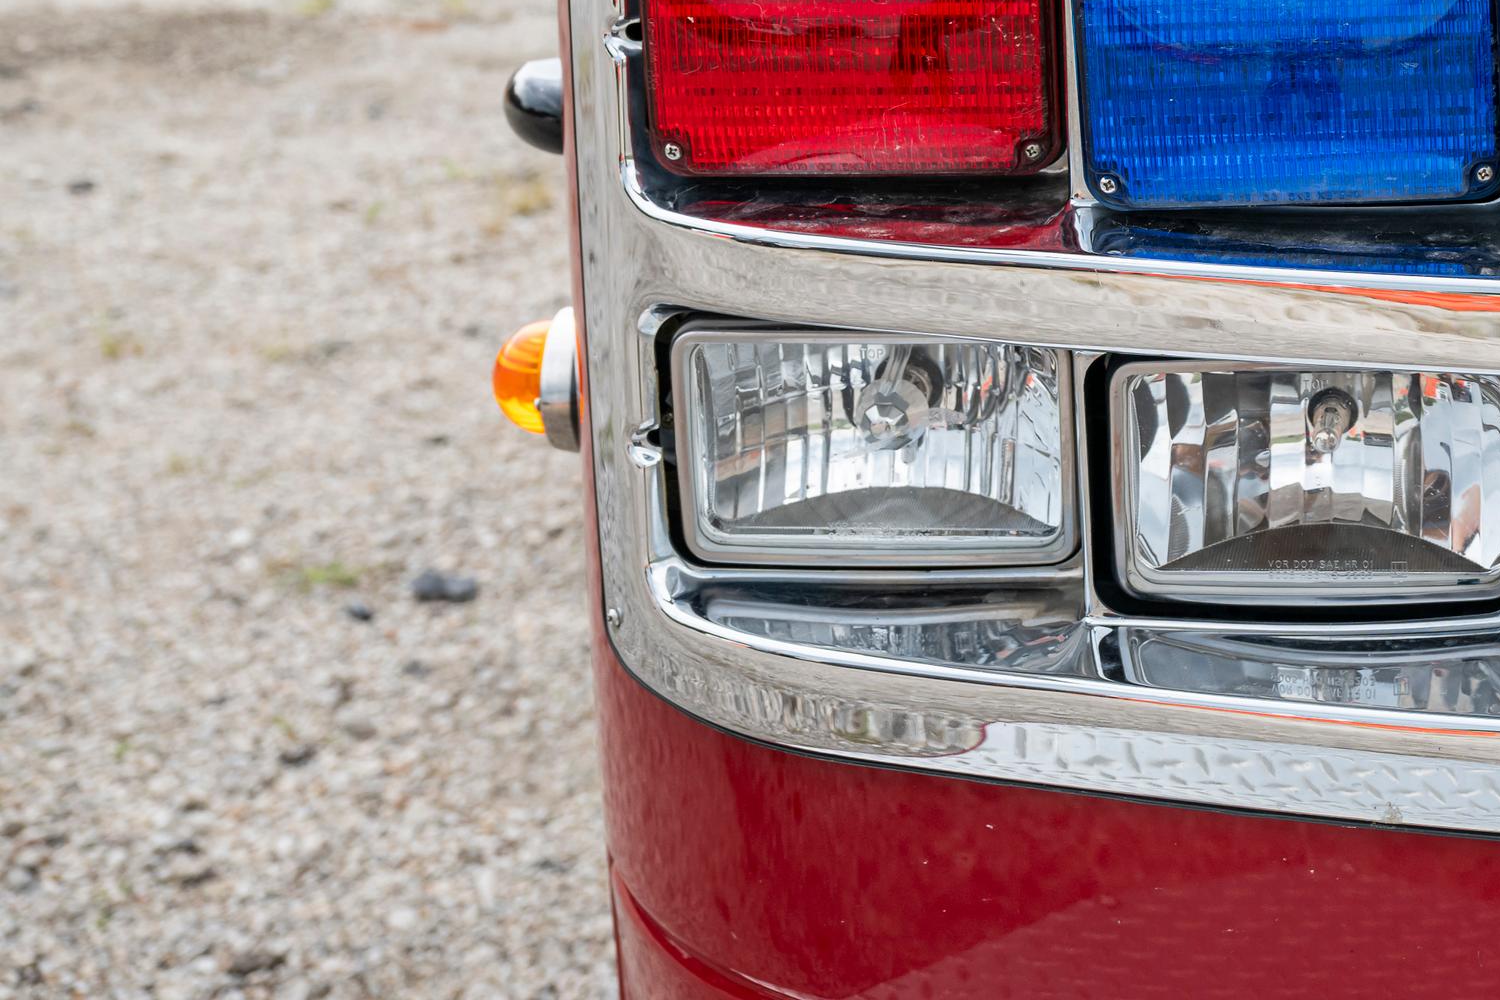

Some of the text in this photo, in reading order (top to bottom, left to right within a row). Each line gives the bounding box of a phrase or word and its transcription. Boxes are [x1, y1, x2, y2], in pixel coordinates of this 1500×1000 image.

[861, 347, 884, 360] TOP
[1267, 559, 1289, 569] VOR
[1293, 559, 1314, 569] DOT
[1319, 559, 1340, 569] SAE
[1344, 559, 1358, 569] HR
